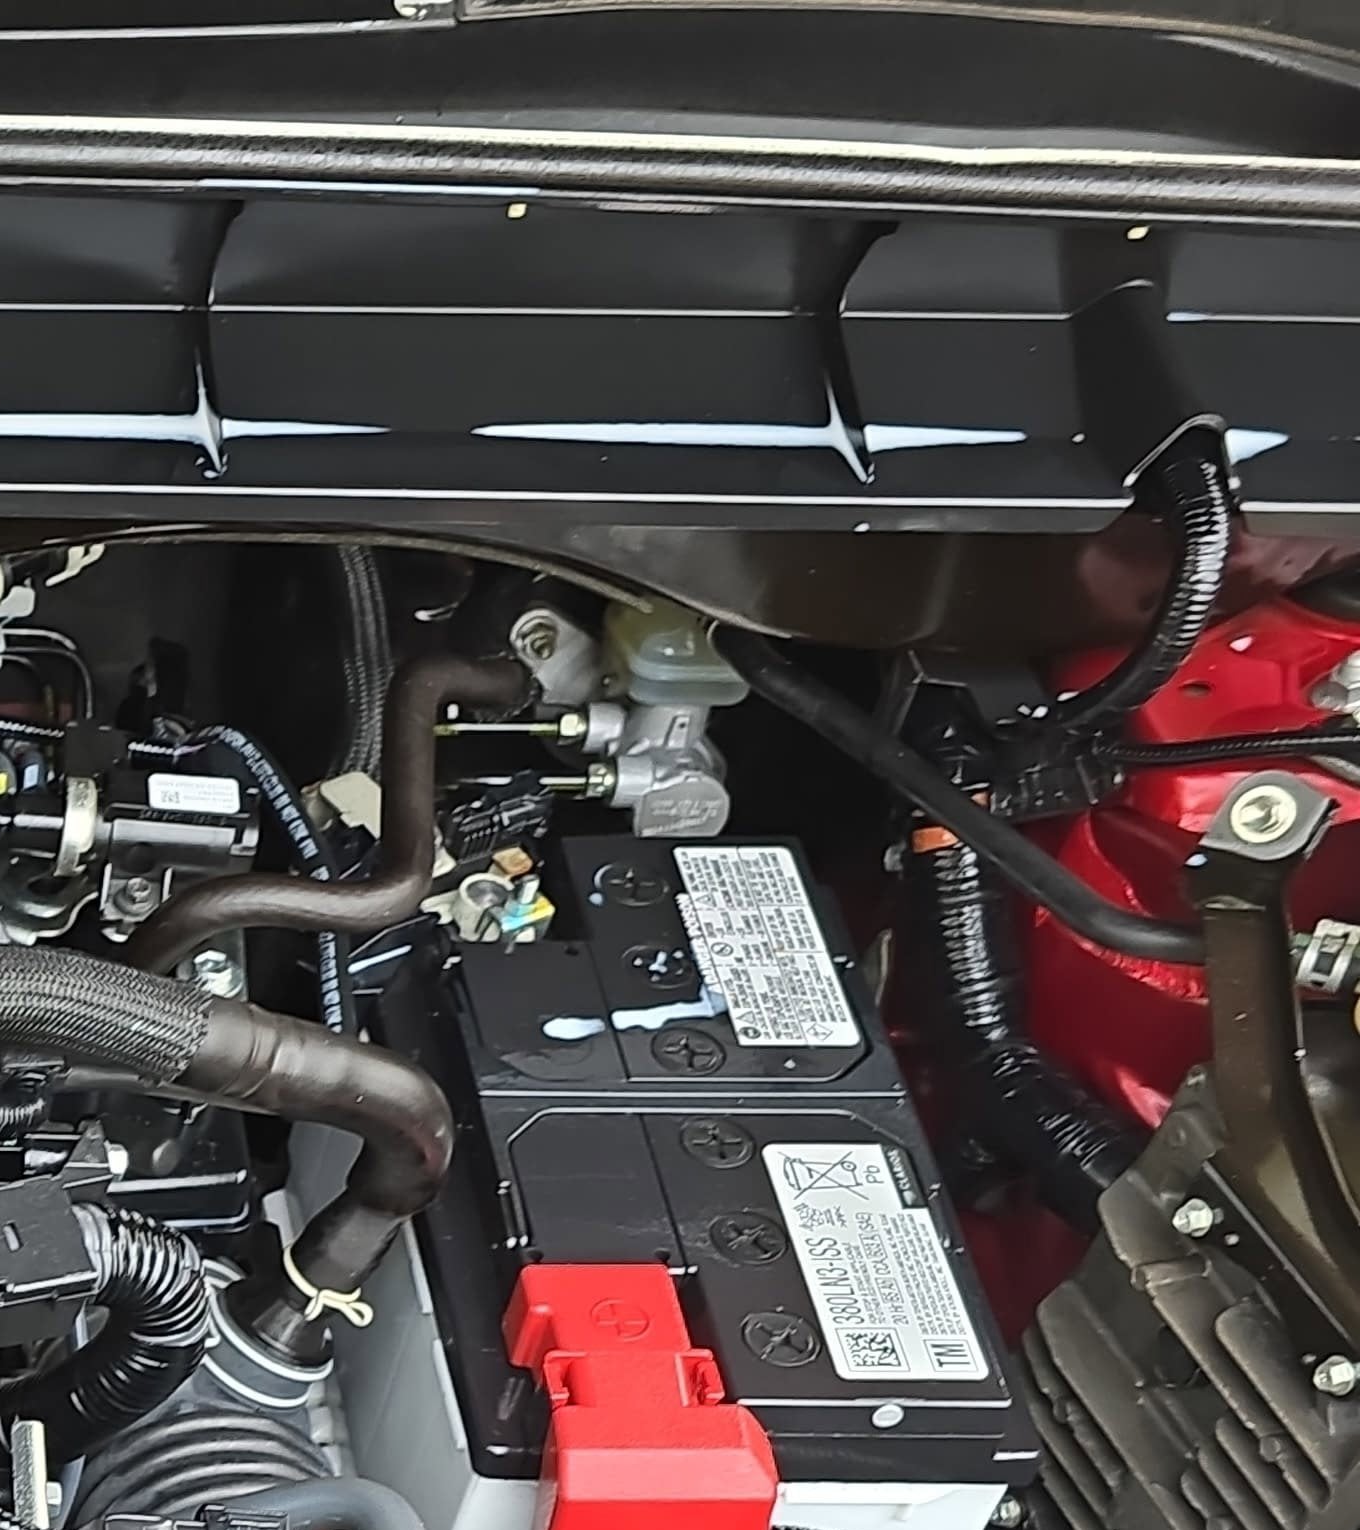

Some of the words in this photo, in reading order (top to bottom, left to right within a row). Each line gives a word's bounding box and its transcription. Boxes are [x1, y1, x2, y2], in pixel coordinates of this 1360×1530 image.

[863, 1165, 884, 1184] Pb
[805, 1237, 864, 1324] 380LN3-ISS
[931, 1344, 971, 1368] TM
